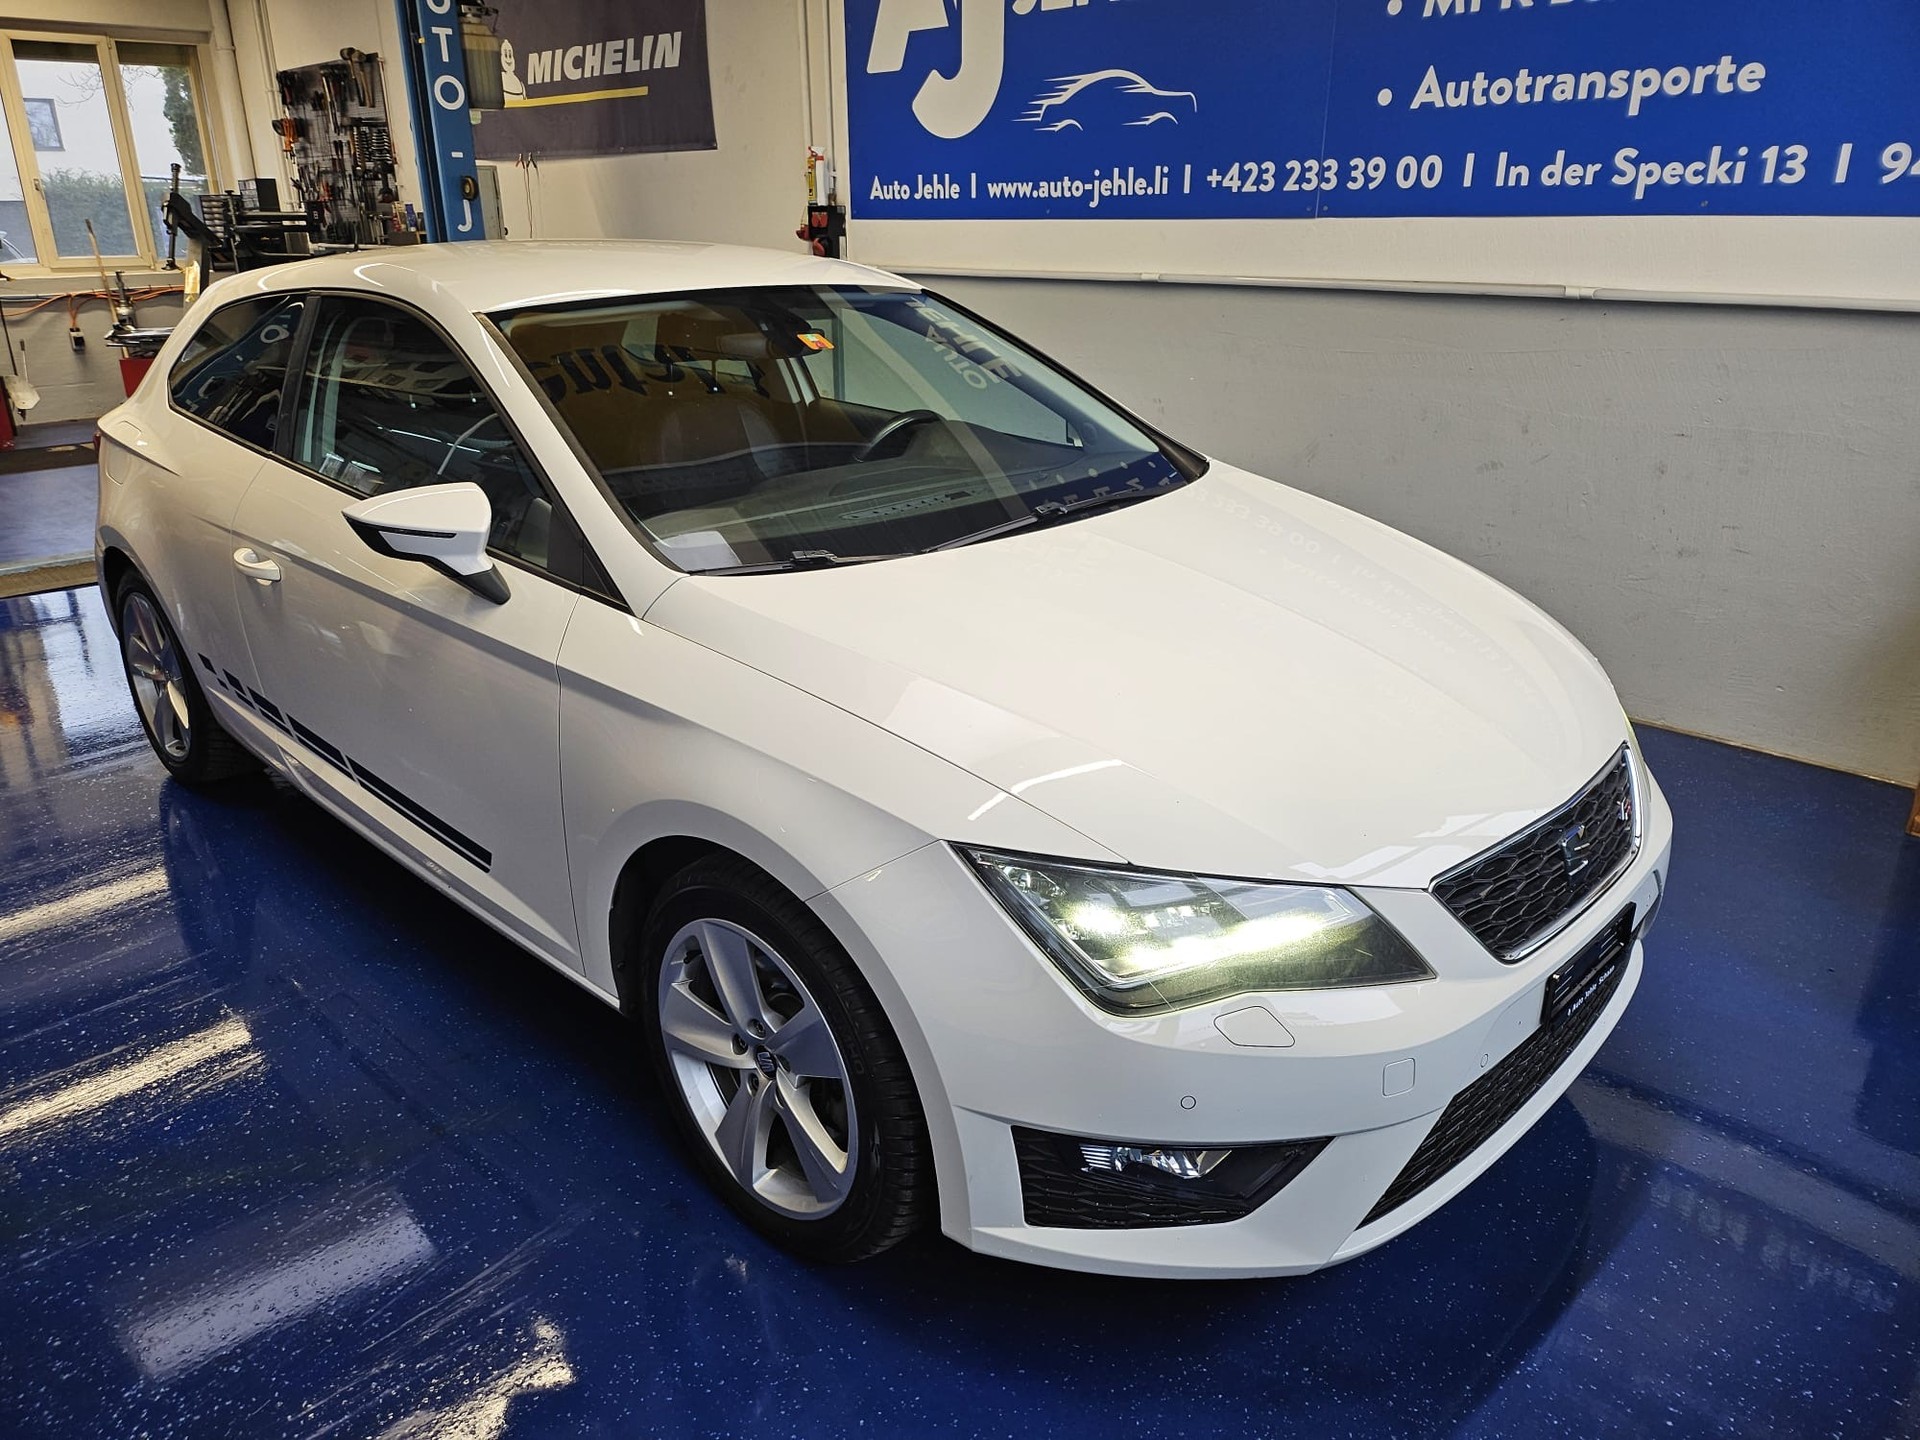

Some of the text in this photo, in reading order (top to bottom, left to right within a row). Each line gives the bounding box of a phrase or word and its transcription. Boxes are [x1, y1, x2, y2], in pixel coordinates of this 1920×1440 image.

[527, 31, 682, 84] MICHELIN
[1410, 55, 1767, 117] Autotransporte
[870, 174, 910, 200] Auto
[914, 172, 960, 200] Jehle
[987, 164, 1169, 209] www.auto-jehle.li
[1206, 159, 1276, 194] +423
[1283, 158, 1339, 192] 233
[1347, 156, 1386, 191] 39
[1396, 154, 1443, 189] 00
[1496, 152, 1529, 188] In
[1541, 149, 1603, 187] der
[1611, 145, 1748, 200] Specki
[1761, 144, 1808, 185] 13
